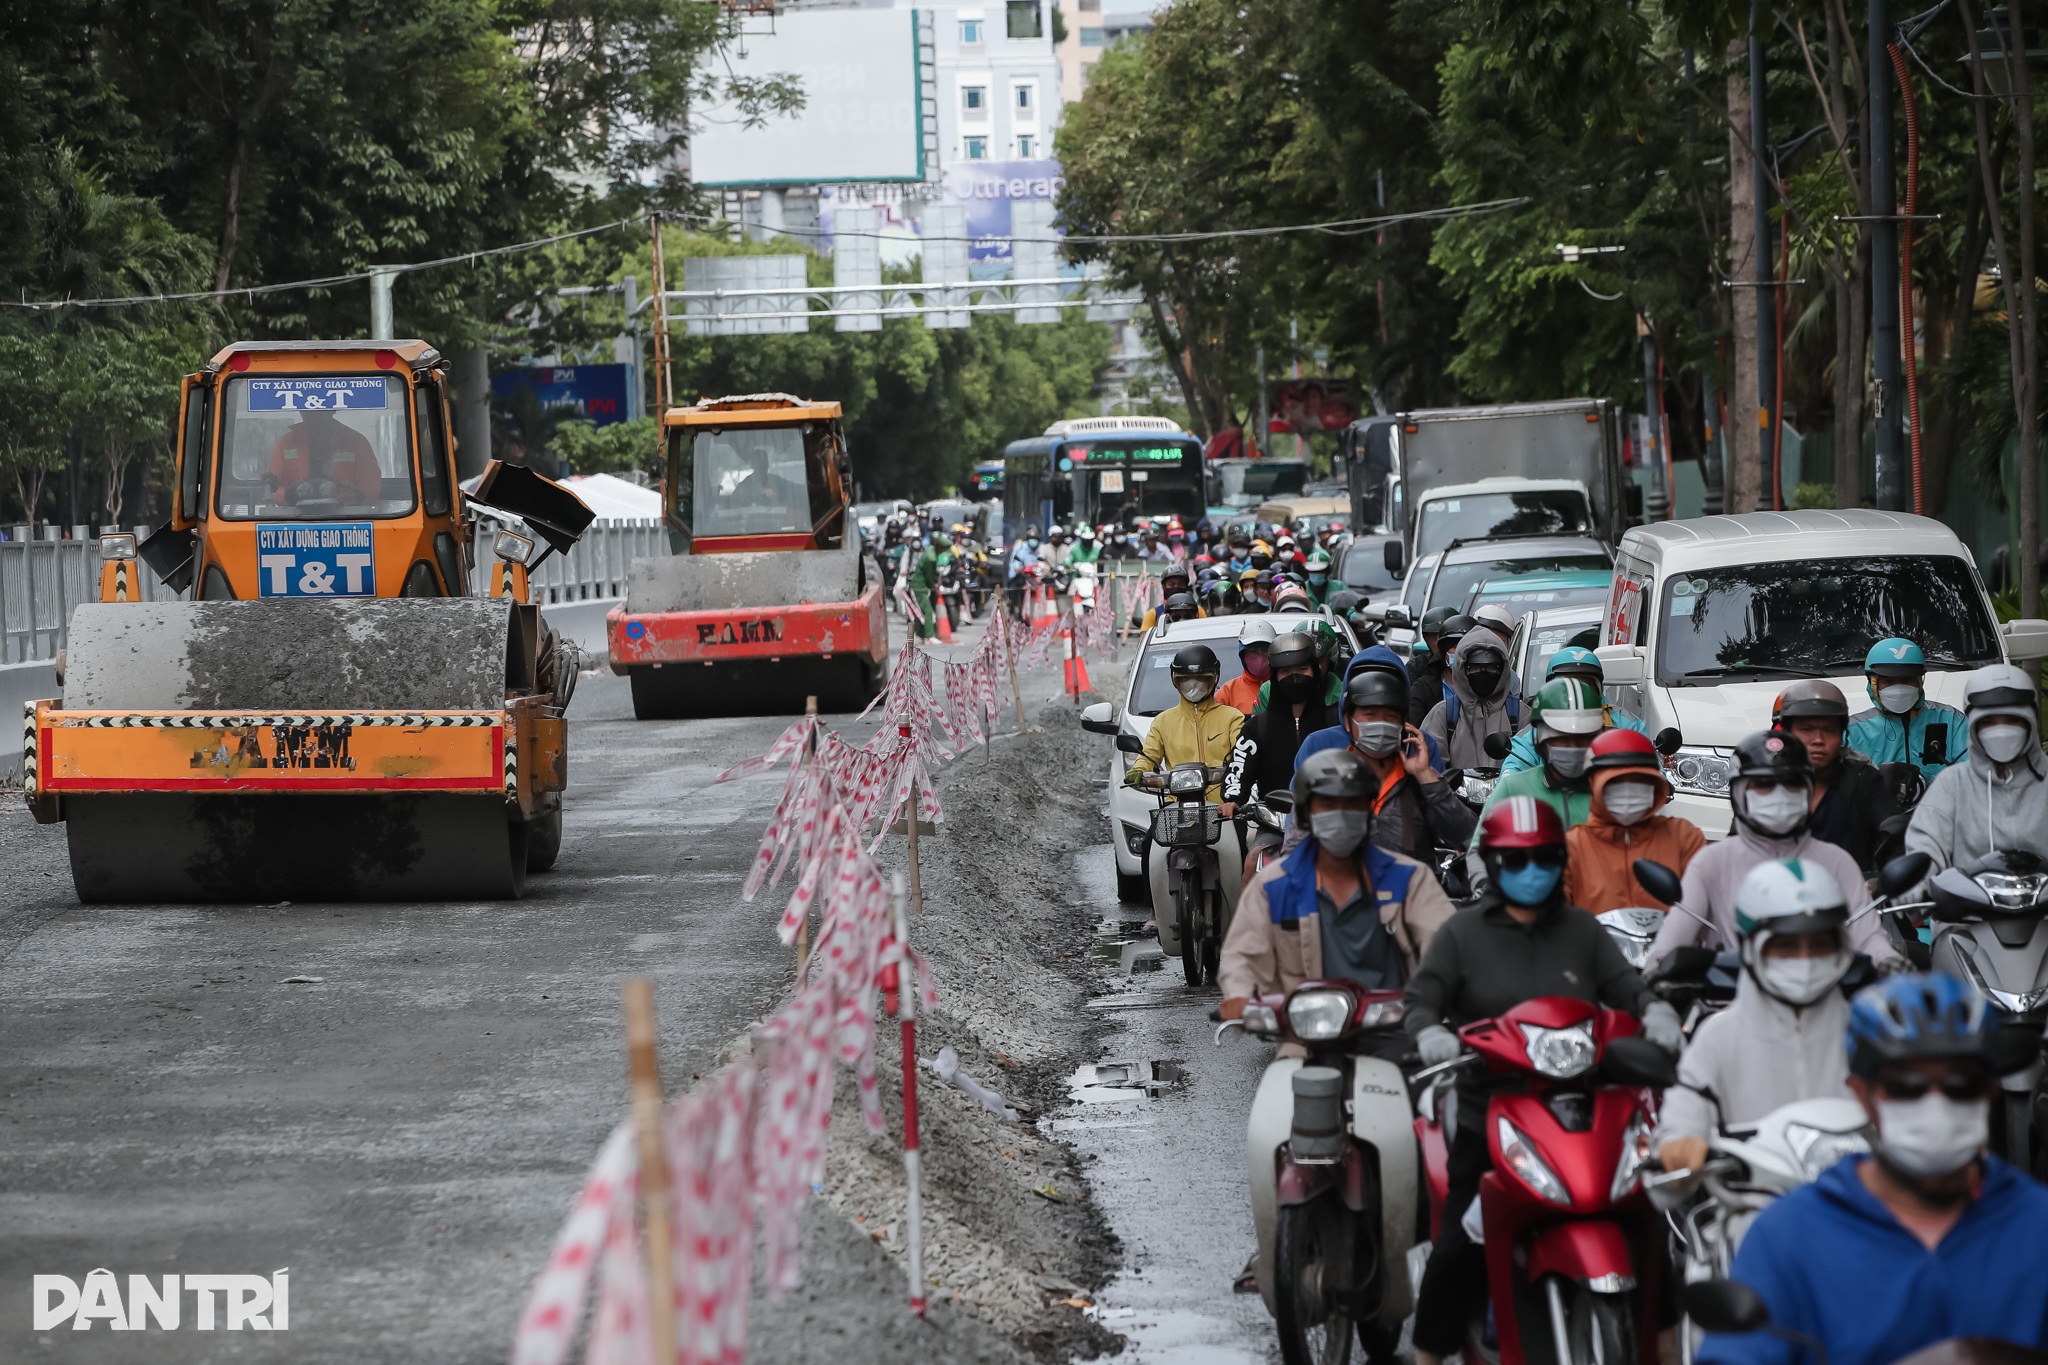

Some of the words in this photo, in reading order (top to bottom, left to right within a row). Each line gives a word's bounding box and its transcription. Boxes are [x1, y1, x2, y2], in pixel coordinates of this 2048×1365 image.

[956, 176, 1066, 200] Ultherap
[252, 382, 271, 390] CTY
[273, 380, 293, 389] XÂY
[295, 380, 322, 391] DỰNG
[324, 381, 347, 389] GIAO
[350, 379, 382, 388] THÔNG
[274, 390, 354, 409] T&T
[588, 398, 617, 415] PVI
[260, 530, 276, 548] CTY
[278, 526, 294, 548] XÂY
[296, 528, 320, 552] DỰNG
[321, 530, 341, 548] GIAO
[342, 526, 370, 547] THÔNG
[261, 553, 371, 594] T&T
